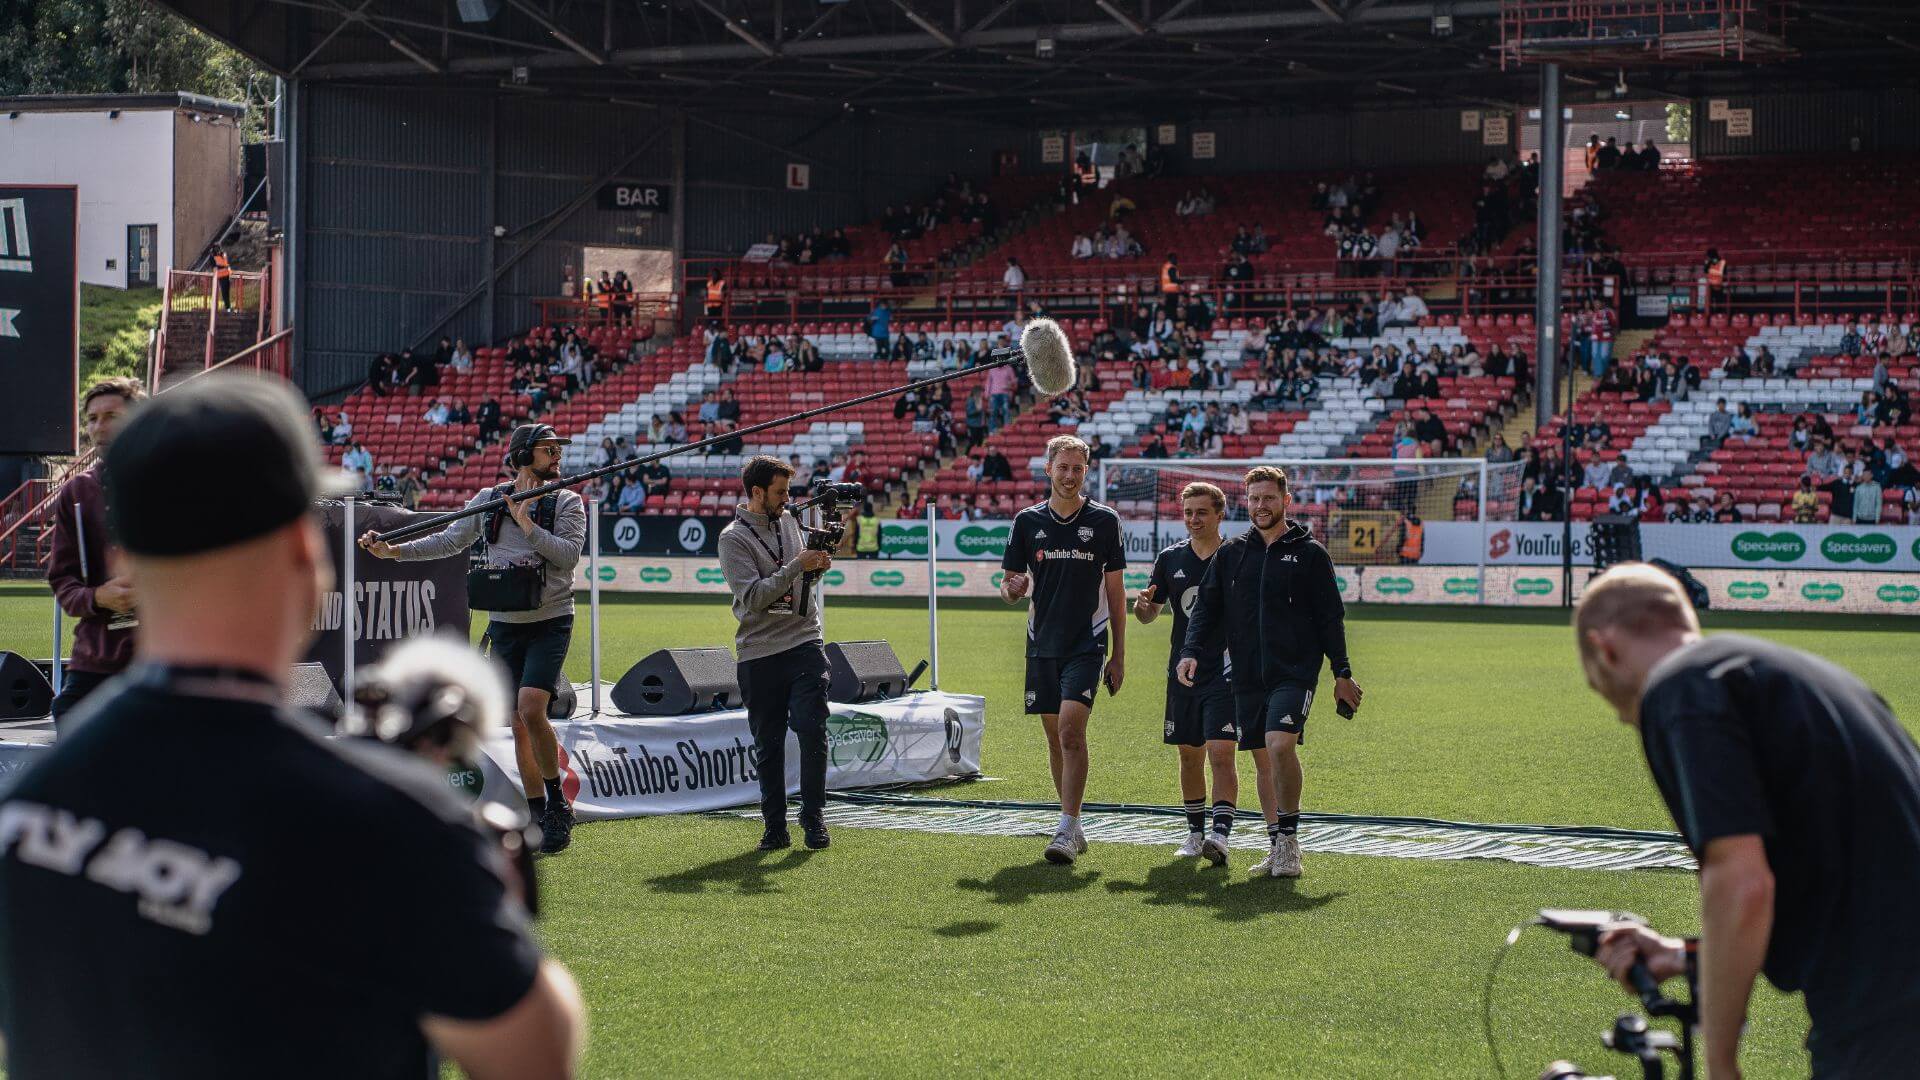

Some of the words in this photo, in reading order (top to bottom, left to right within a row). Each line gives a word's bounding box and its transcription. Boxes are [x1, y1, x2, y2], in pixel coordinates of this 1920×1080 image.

[791, 167, 803, 186] L
[616, 187, 659, 206] BAR
[618, 526, 636, 540] JD
[683, 527, 702, 542] JD
[1355, 527, 1375, 547] 21
[1044, 549, 1071, 560] YouTube
[1071, 548, 1095, 561] Shorts
[1516, 534, 1581, 556] YouTue
[1737, 539, 1800, 556] Specsavers
[1827, 540, 1892, 558] Specsavers
[311, 591, 343, 630] AND
[354, 580, 435, 640] STATUS
[572, 743, 680, 798] YouTube
